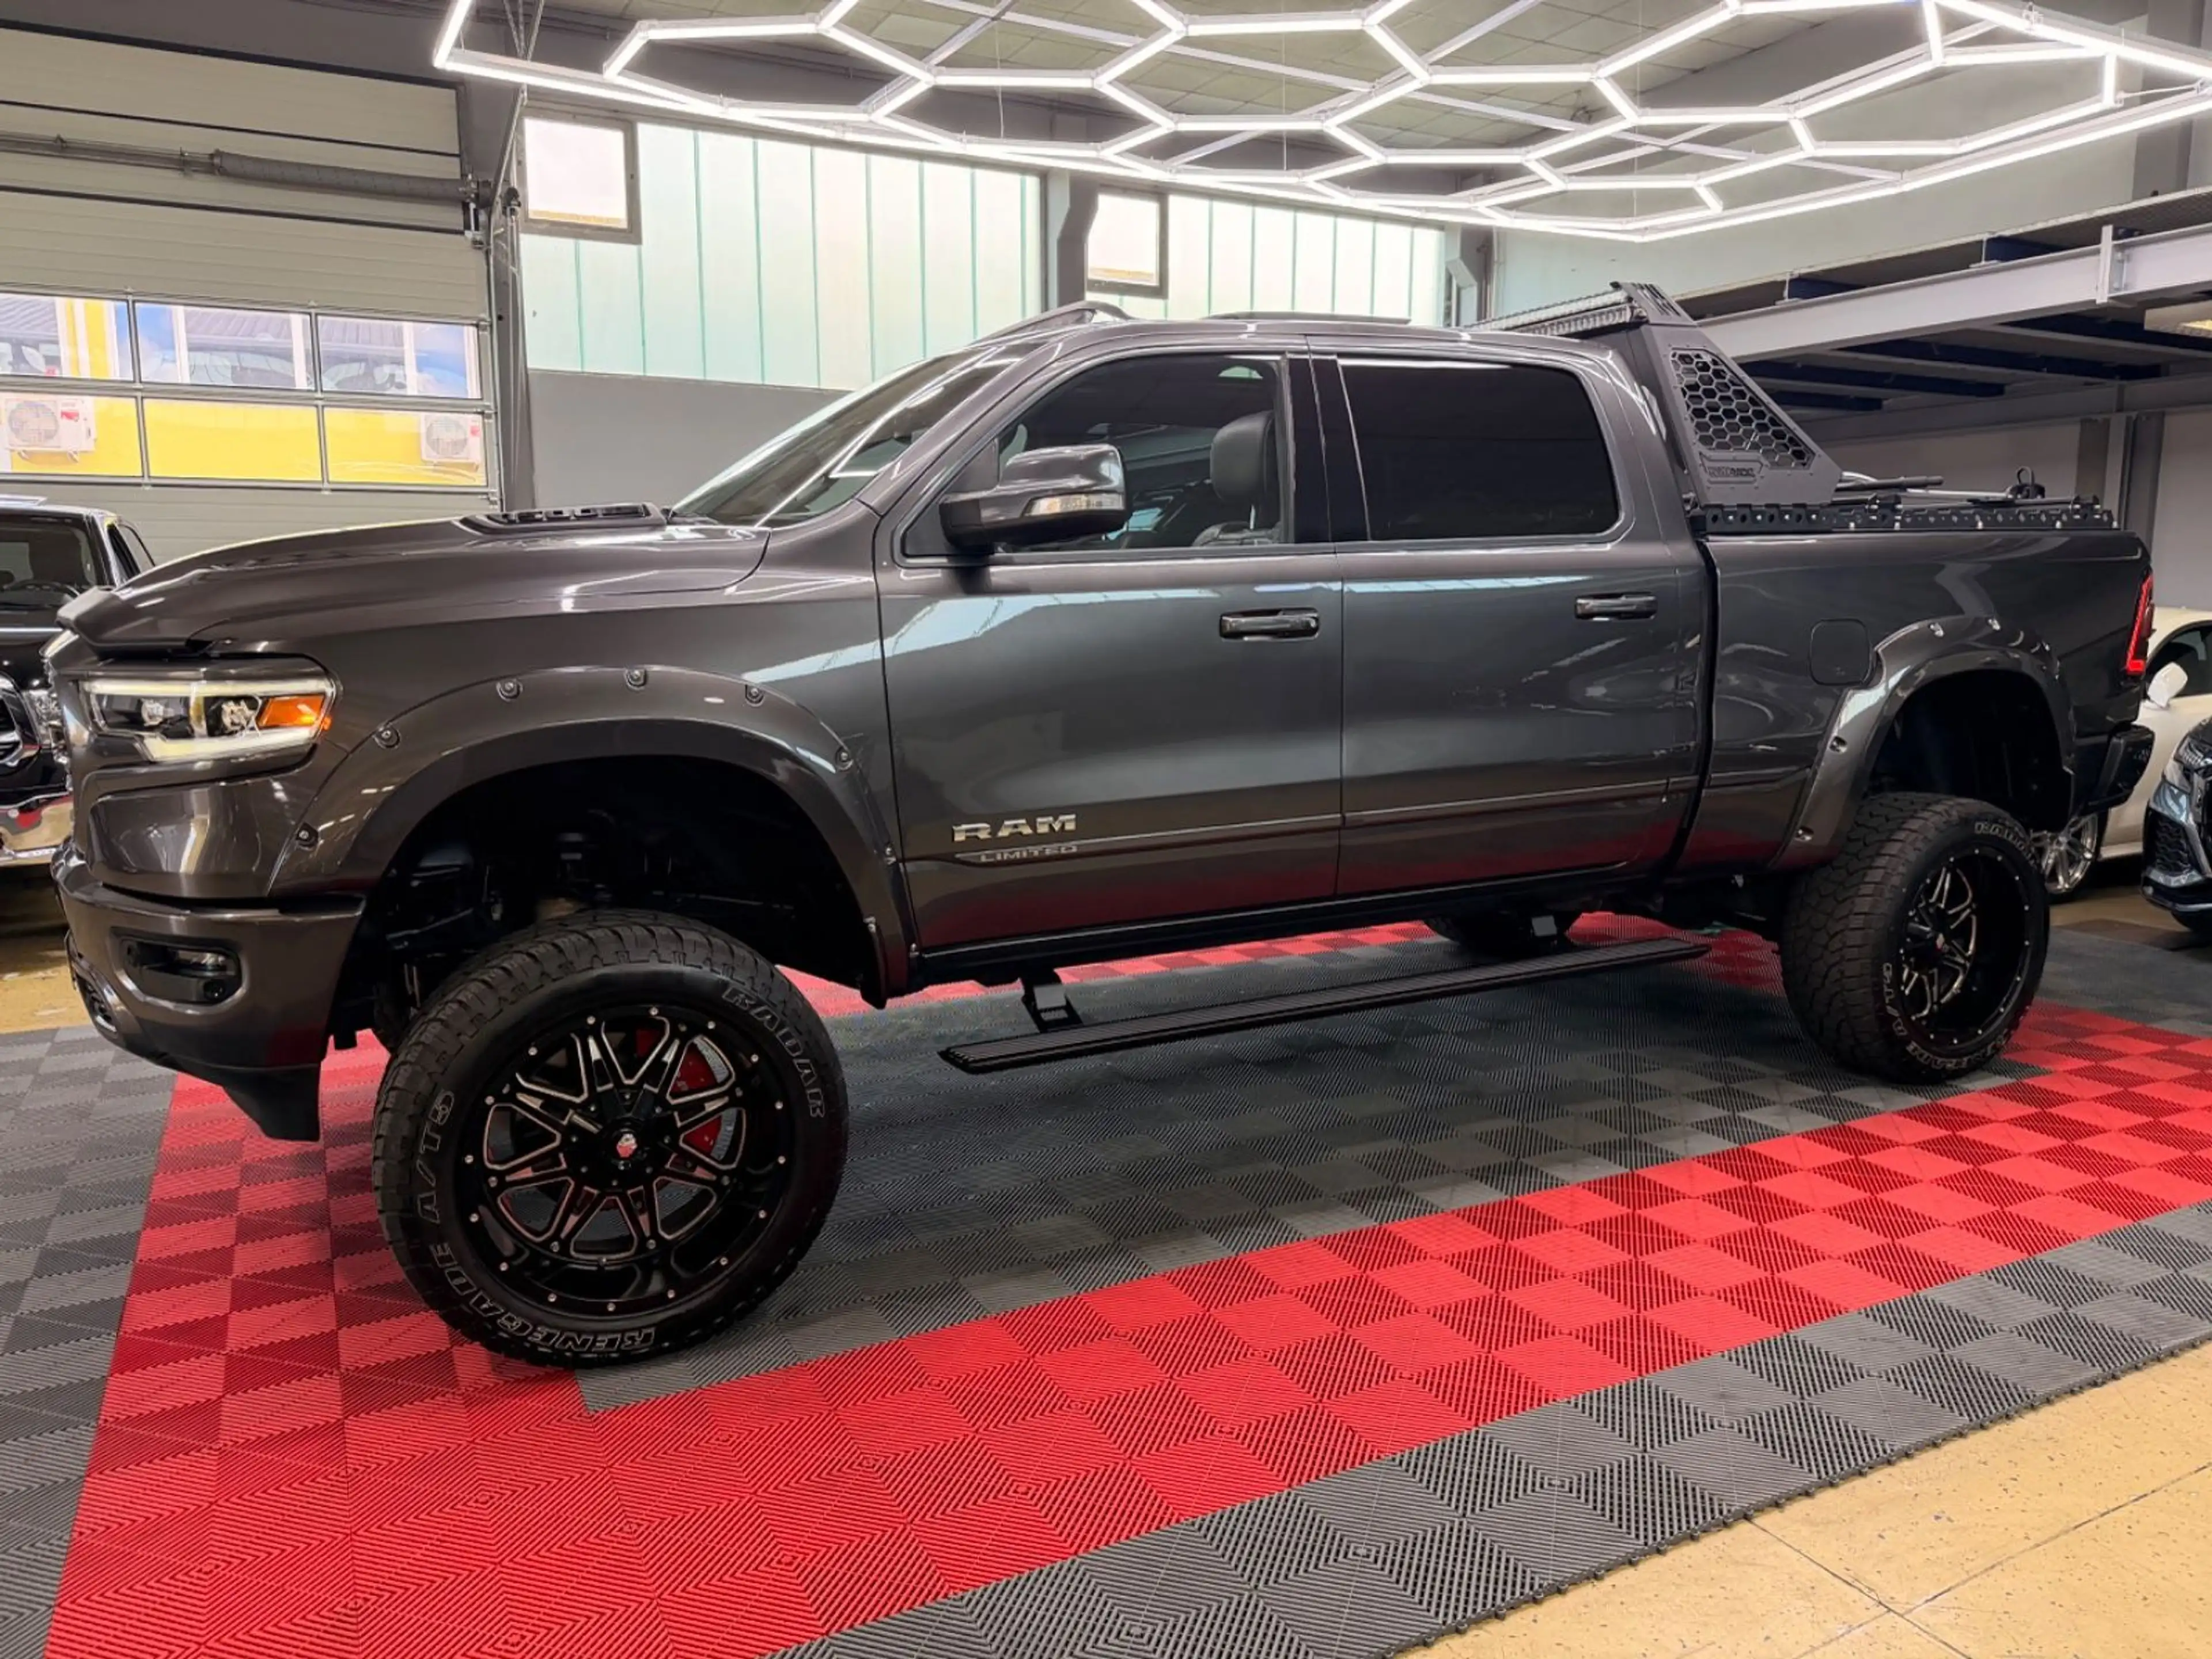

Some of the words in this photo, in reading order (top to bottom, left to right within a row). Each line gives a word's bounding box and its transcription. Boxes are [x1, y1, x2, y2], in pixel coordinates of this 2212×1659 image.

[952, 813, 1076, 842] RAM
[980, 846, 1077, 862] LIMITED
[724, 987, 824, 1118] RADAR
[429, 1243, 656, 1351] RENEGADE
